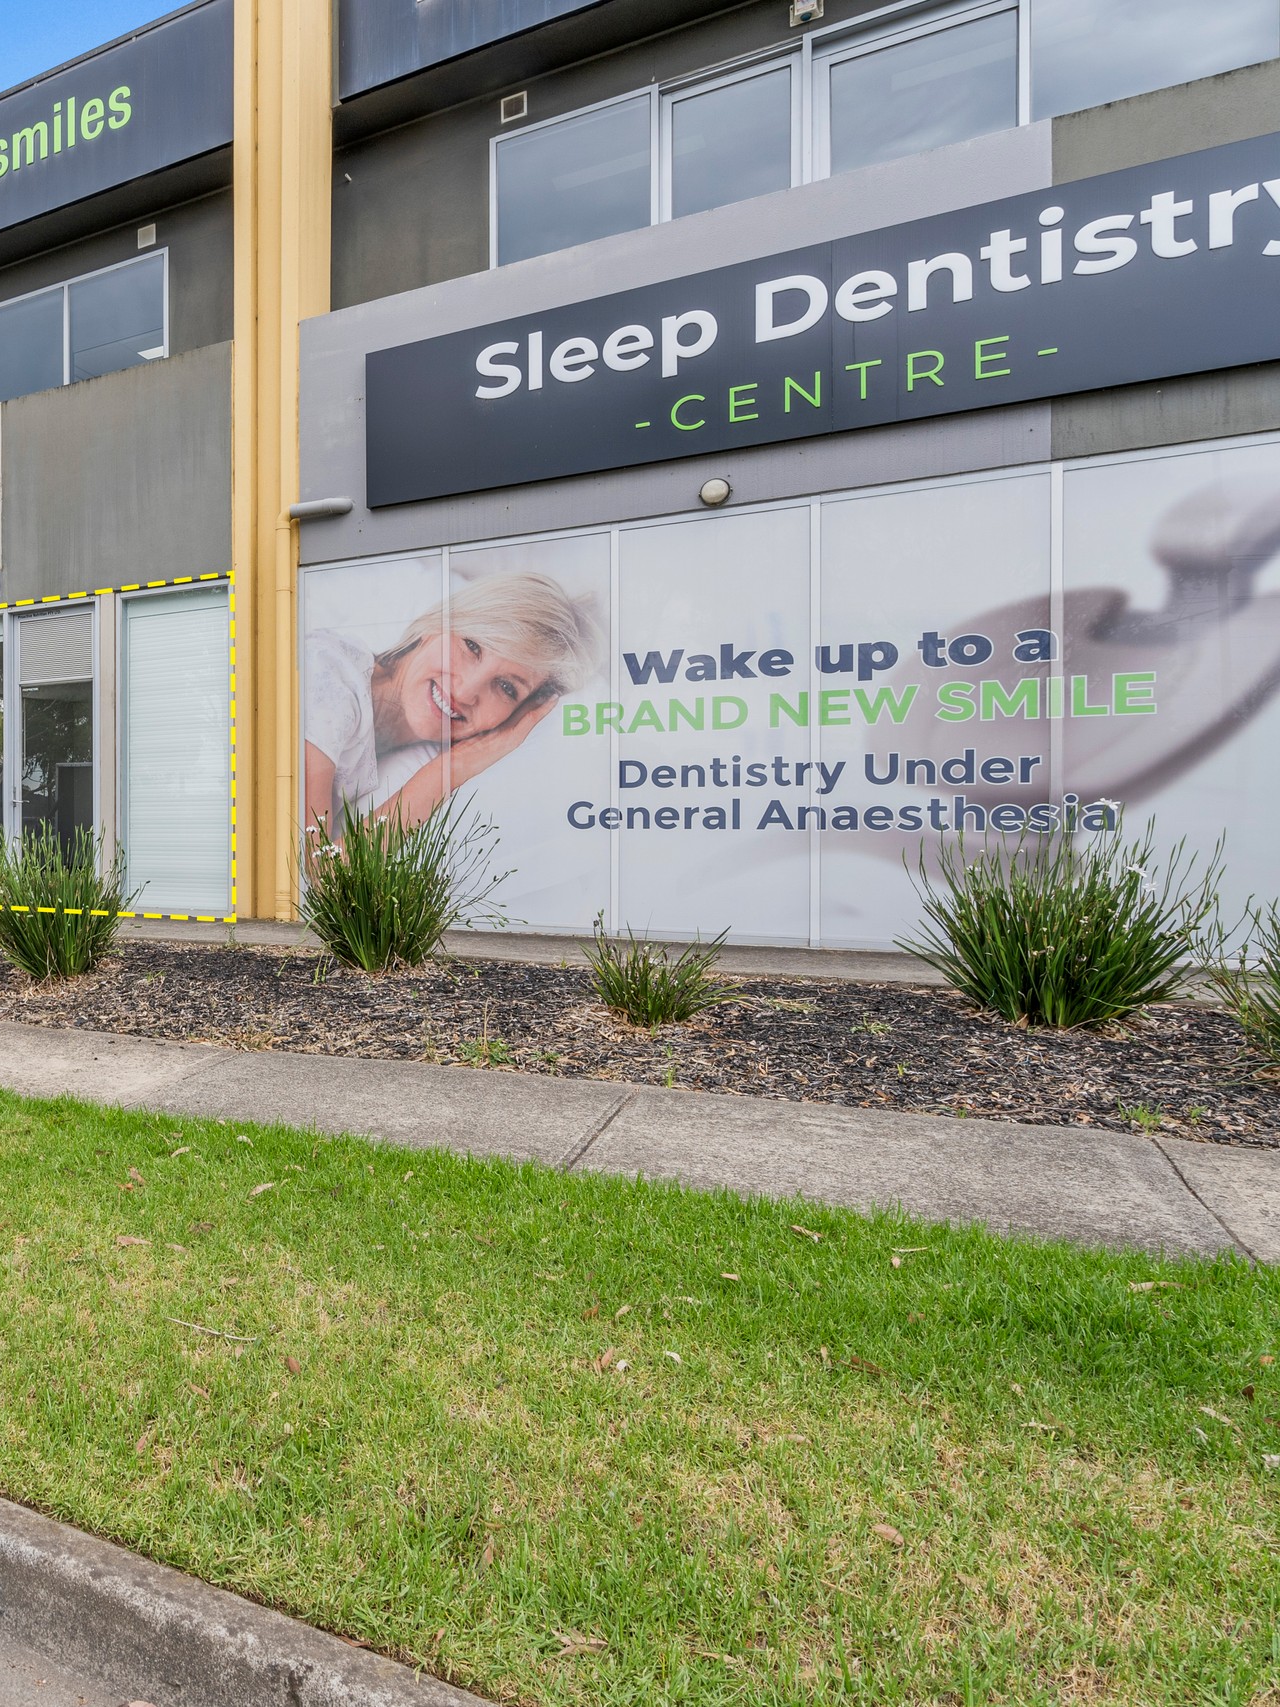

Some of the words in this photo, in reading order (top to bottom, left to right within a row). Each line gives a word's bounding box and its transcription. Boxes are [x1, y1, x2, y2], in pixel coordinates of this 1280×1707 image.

[474, 309, 718, 402] Sleep
[754, 178, 1280, 344] Dentistr
[622, 644, 795, 686] Wake
[815, 639, 899, 682] up
[916, 630, 995, 668] to
[1013, 628, 1060, 663] a
[561, 693, 747, 737] BRAND
[768, 686, 919, 729] NEW
[934, 671, 1158, 723] SMILE
[617, 755, 846, 795] Dentistry
[863, 747, 1042, 788] Under
[566, 796, 742, 832] General
[756, 793, 1118, 834] Anaesthesia
